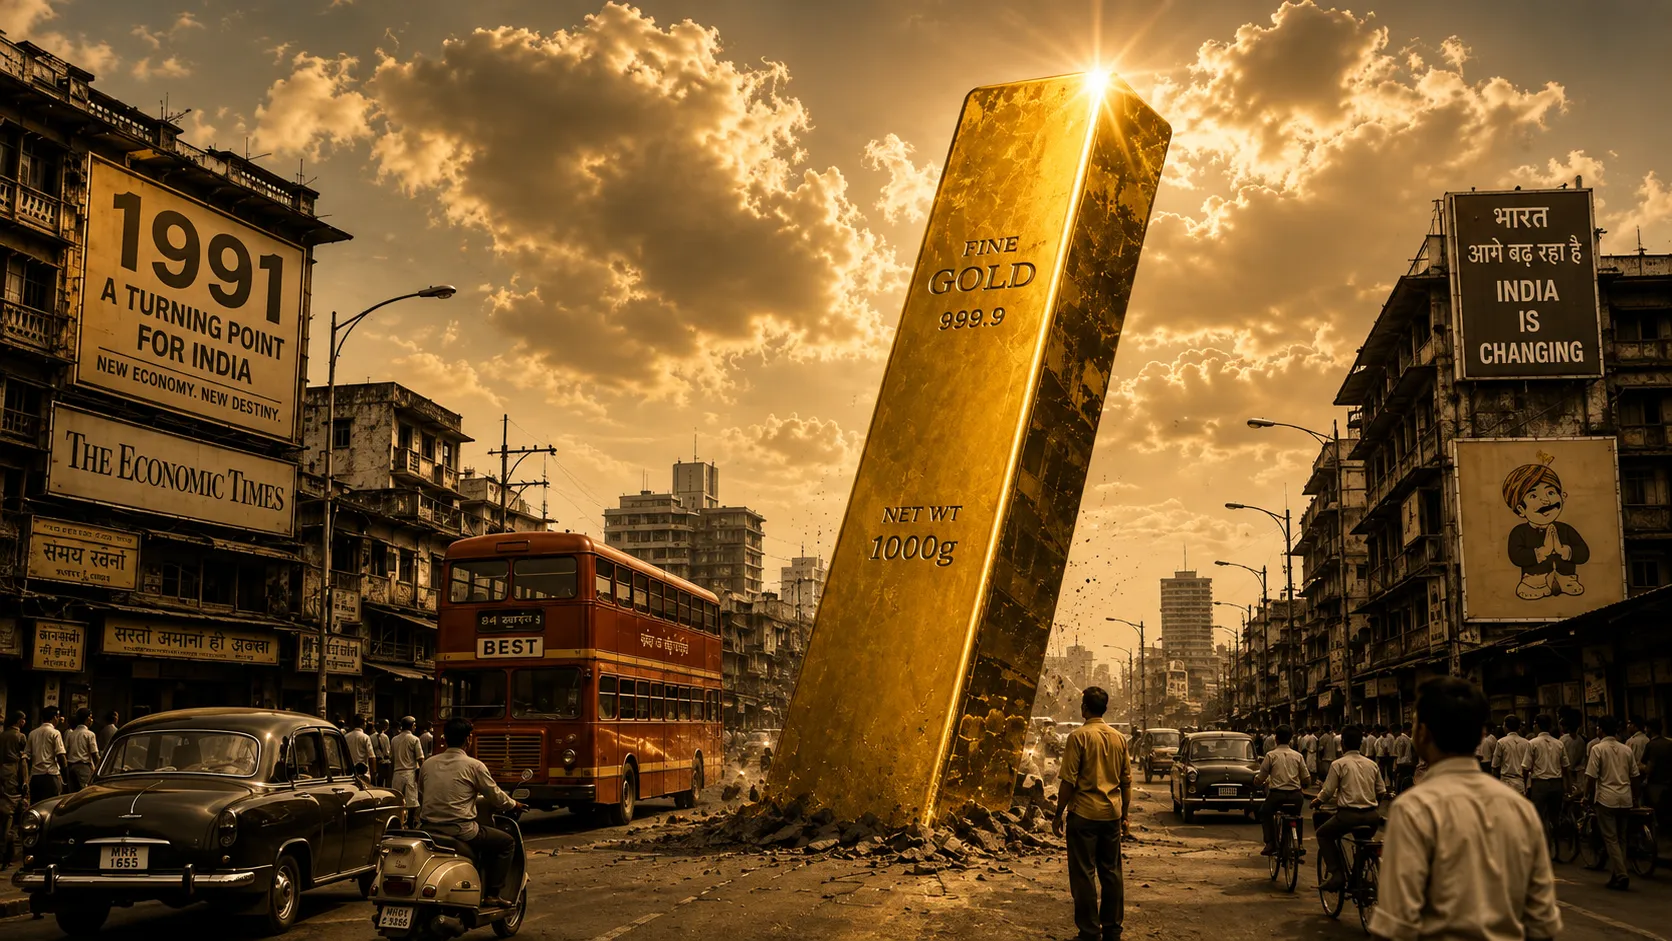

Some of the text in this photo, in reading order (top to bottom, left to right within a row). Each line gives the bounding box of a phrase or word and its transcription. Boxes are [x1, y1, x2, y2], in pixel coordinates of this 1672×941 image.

[1494, 207, 1549, 228] भारत
[113, 191, 283, 324] 1991
[962, 236, 1019, 257] FINE
[1508, 244, 1533, 267] बढ़
[1537, 243, 1565, 265] रहा
[1569, 235, 1582, 264] है
[928, 261, 1037, 295] GOLD
[1497, 279, 1559, 302] INDIA
[100, 277, 285, 360] A TURNING POINT
[937, 307, 1006, 332] 999.9
[1519, 309, 1540, 332] IS
[138, 324, 252, 384] FOR INDIA
[1479, 341, 1584, 364] CHANGING
[97, 355, 281, 422] NEW ECONOMY. NEW DESTINY.
[66, 430, 284, 511] THE ECONOMIC TIMES
[881, 505, 962, 523] NET WT
[869, 534, 958, 566] 1000g
[484, 639, 538, 655] BEST
[111, 858, 138, 867] 1655
